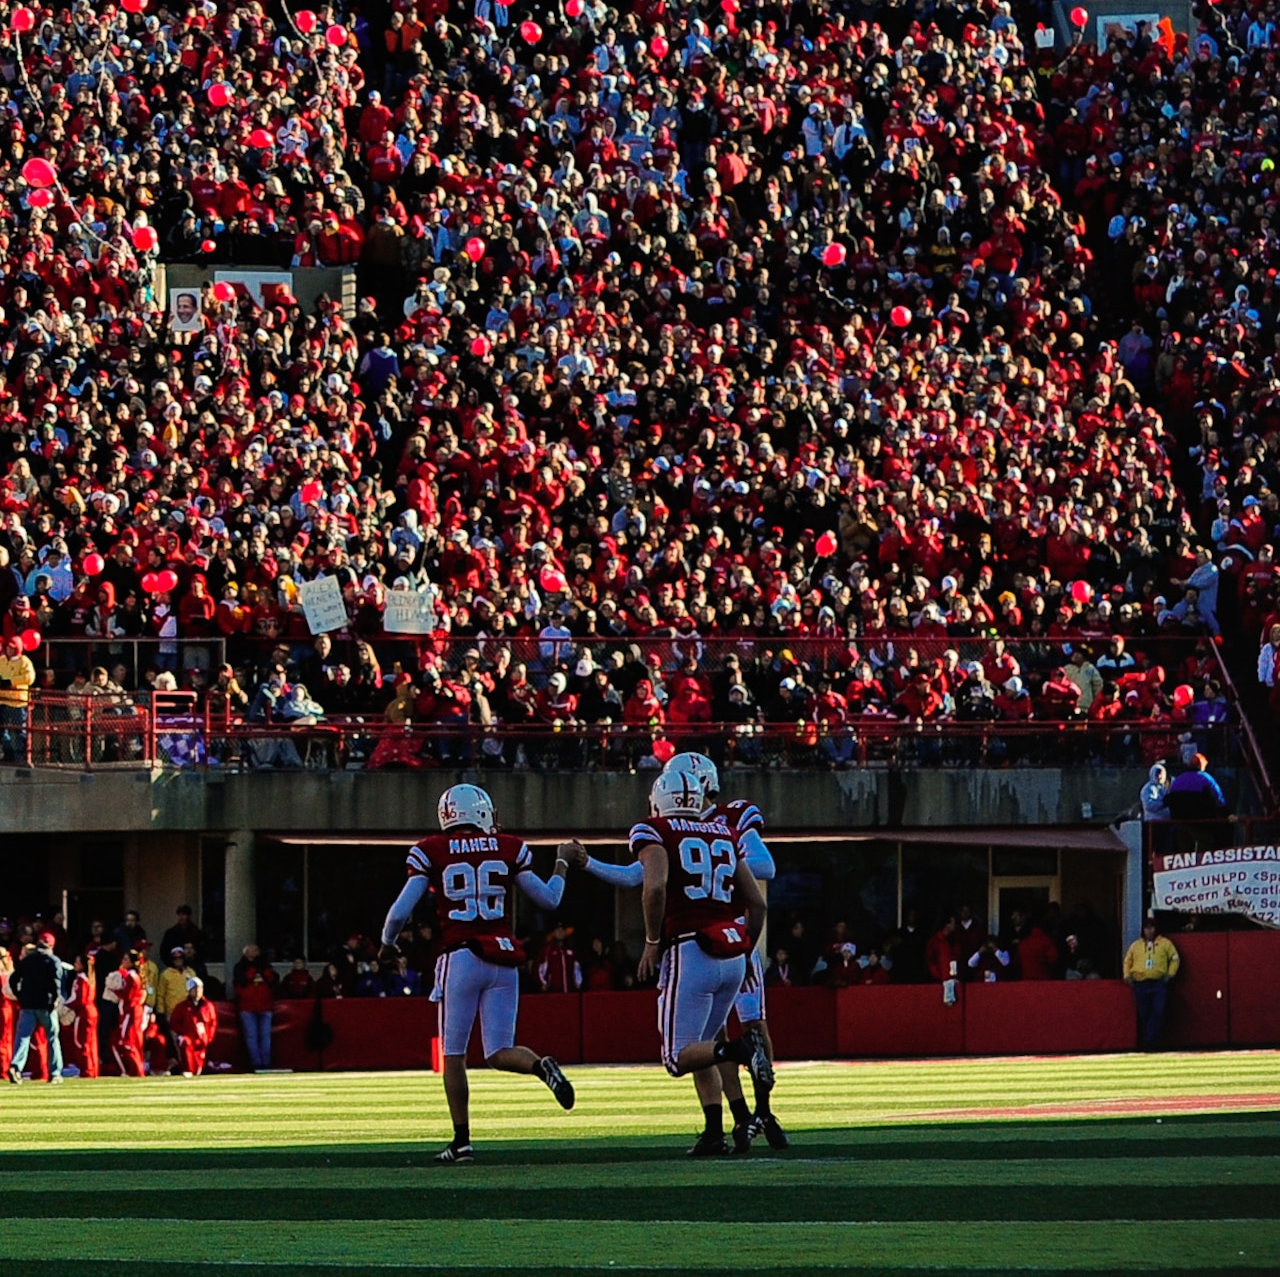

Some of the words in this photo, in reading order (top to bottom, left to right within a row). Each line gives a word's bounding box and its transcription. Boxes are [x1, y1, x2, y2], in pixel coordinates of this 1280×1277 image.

[449, 837, 499, 855] MAHER
[678, 837, 737, 903] 92
[1163, 852, 1198, 871] FAN
[442, 860, 508, 921] 96
[1168, 878, 1198, 892] Text
[1201, 871, 1247, 886] UNLPD
[1164, 890, 1219, 906] Concern
[1223, 886, 1232, 897] &
